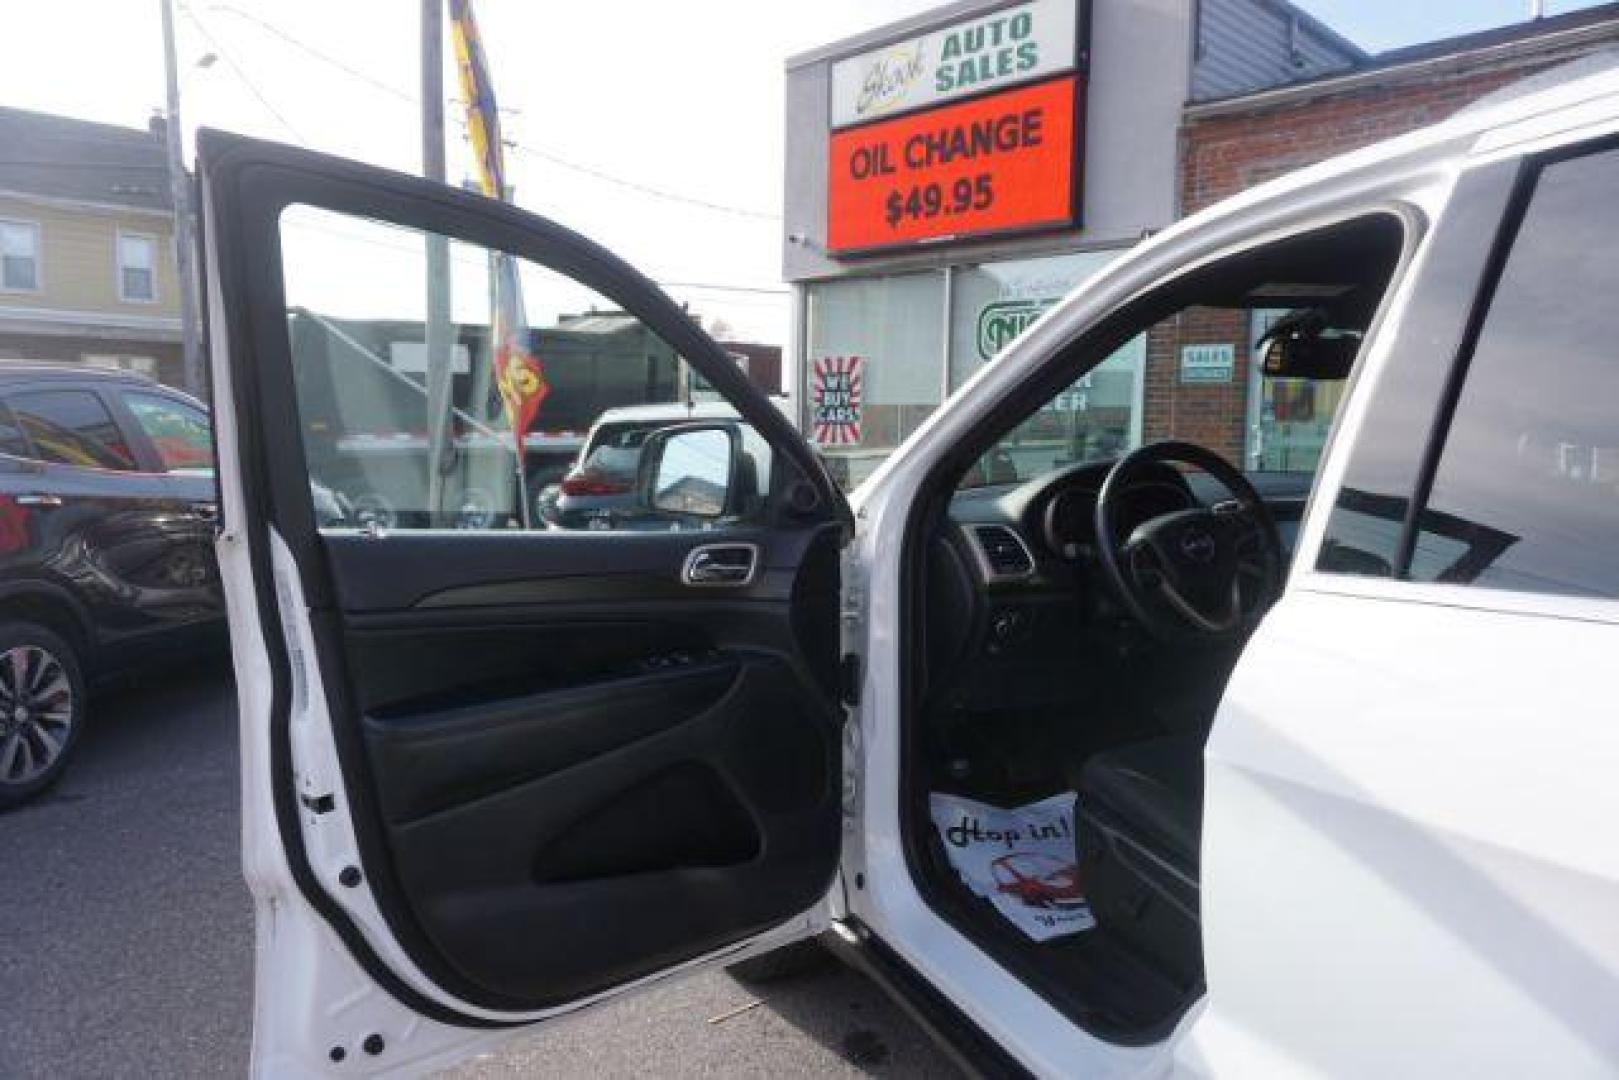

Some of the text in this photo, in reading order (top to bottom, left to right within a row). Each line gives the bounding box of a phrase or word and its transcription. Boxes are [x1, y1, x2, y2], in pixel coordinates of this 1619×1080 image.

[940, 11, 1033, 61] AUTO
[934, 42, 1039, 92] SALES
[850, 107, 1044, 180] OIL CHANGE
[885, 173, 994, 229] $49.95
[816, 406, 857, 422] CARS
[823, 391, 851, 406] BUY
[947, 814, 1070, 849] Hop in!
